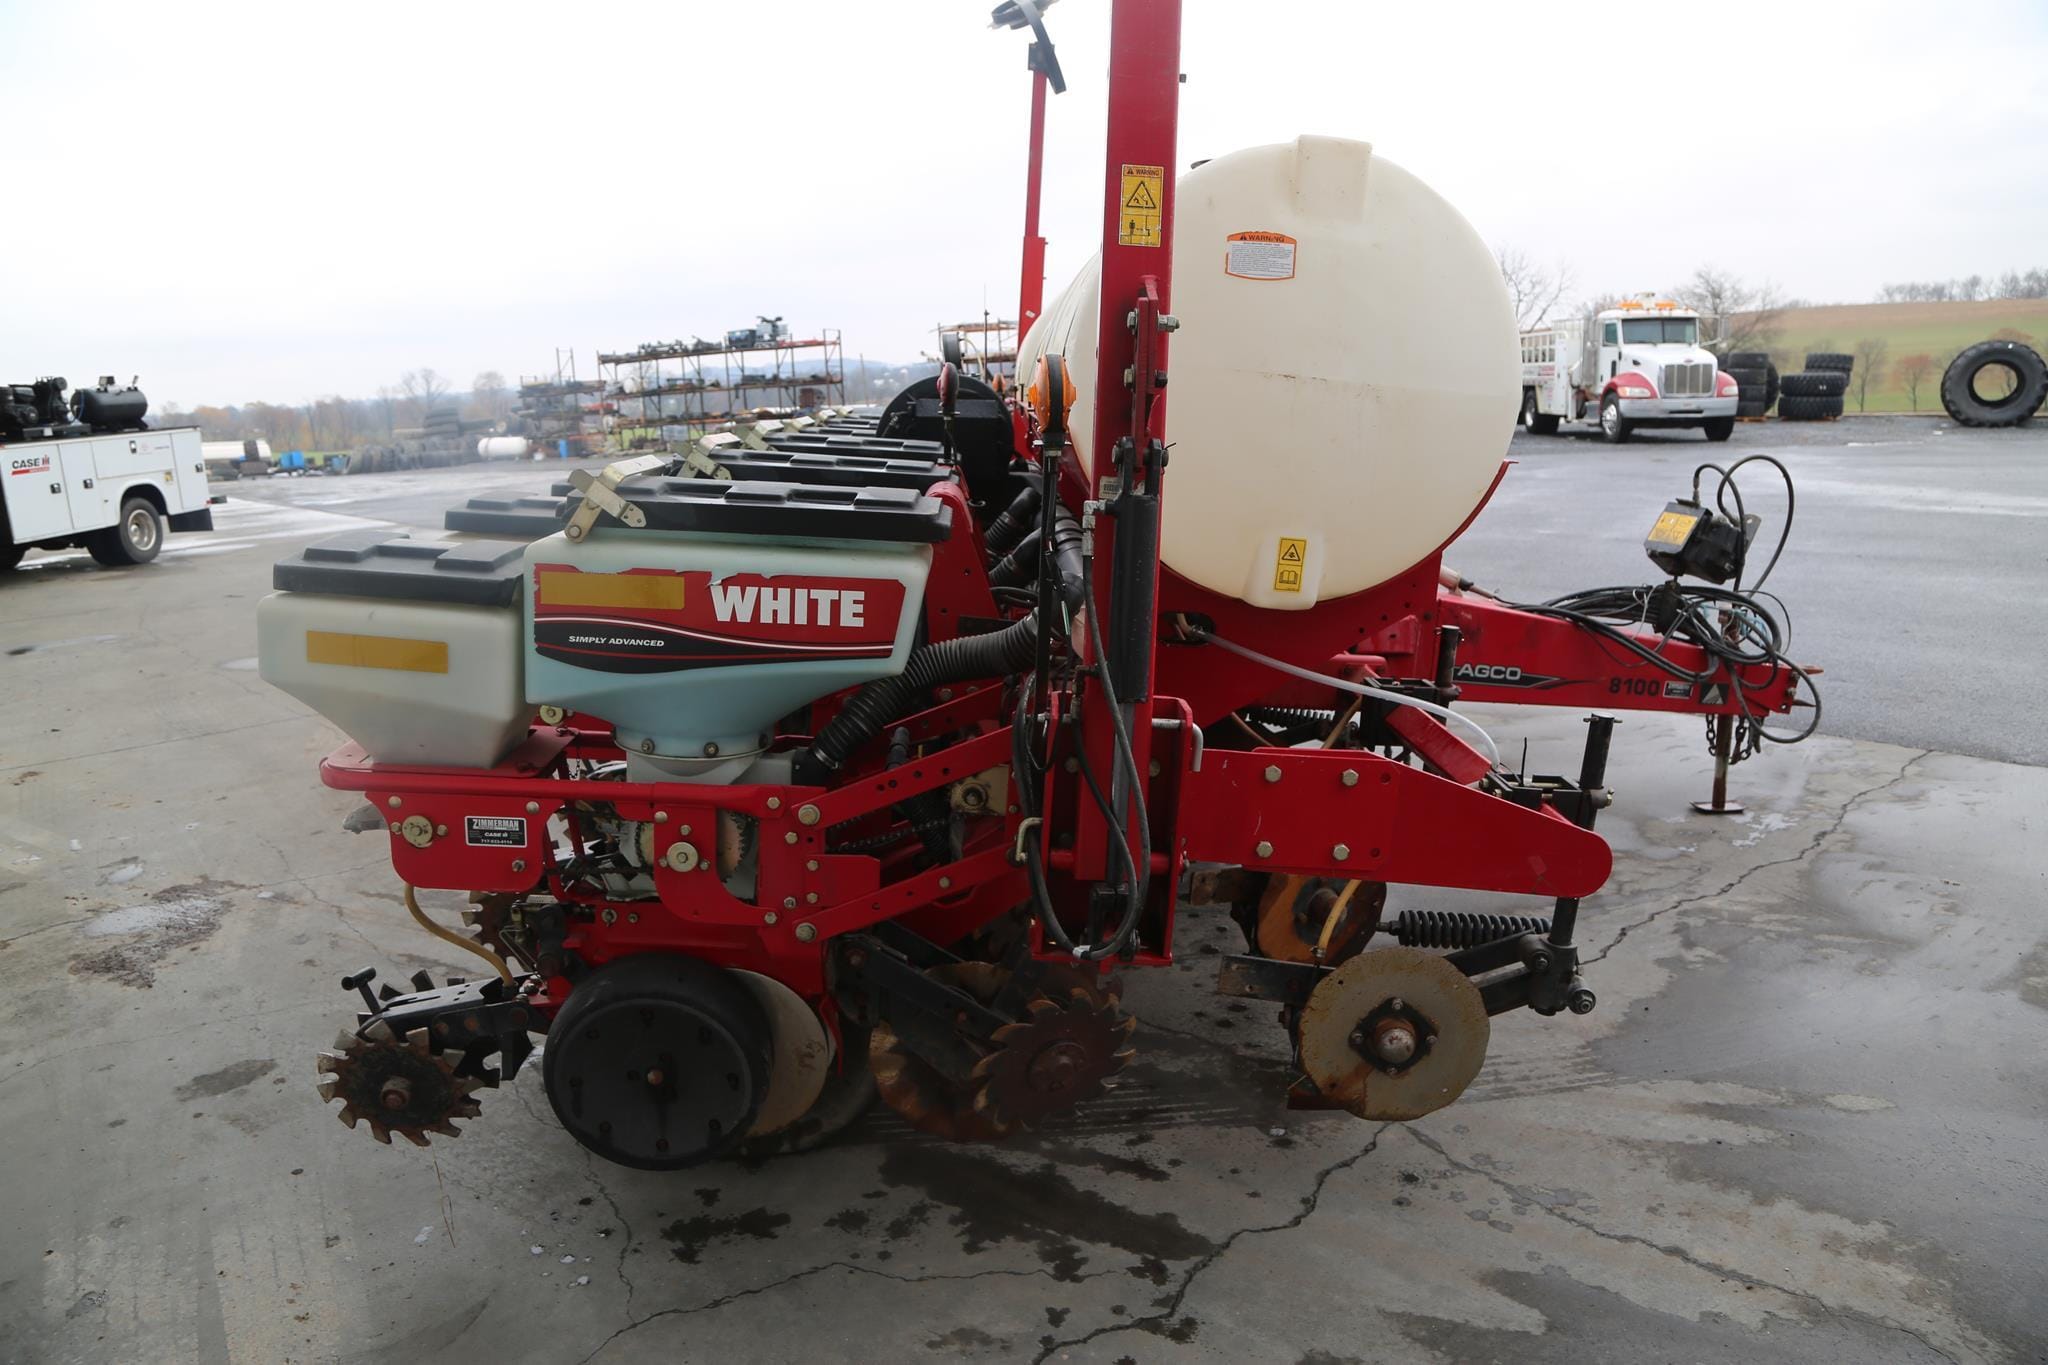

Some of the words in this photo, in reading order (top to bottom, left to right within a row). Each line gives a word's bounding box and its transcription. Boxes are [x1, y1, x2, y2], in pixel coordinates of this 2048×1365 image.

[1135, 168, 1160, 177] WARNING
[12, 458, 40, 469] CASE
[710, 585, 865, 627] WHITE
[568, 635, 607, 645] SIMPLY
[608, 638, 665, 647] ADVANCED
[1457, 663, 1522, 681] AGCO
[1608, 676, 1661, 697] 8100
[472, 818, 519, 831] ZIMMERMAN
